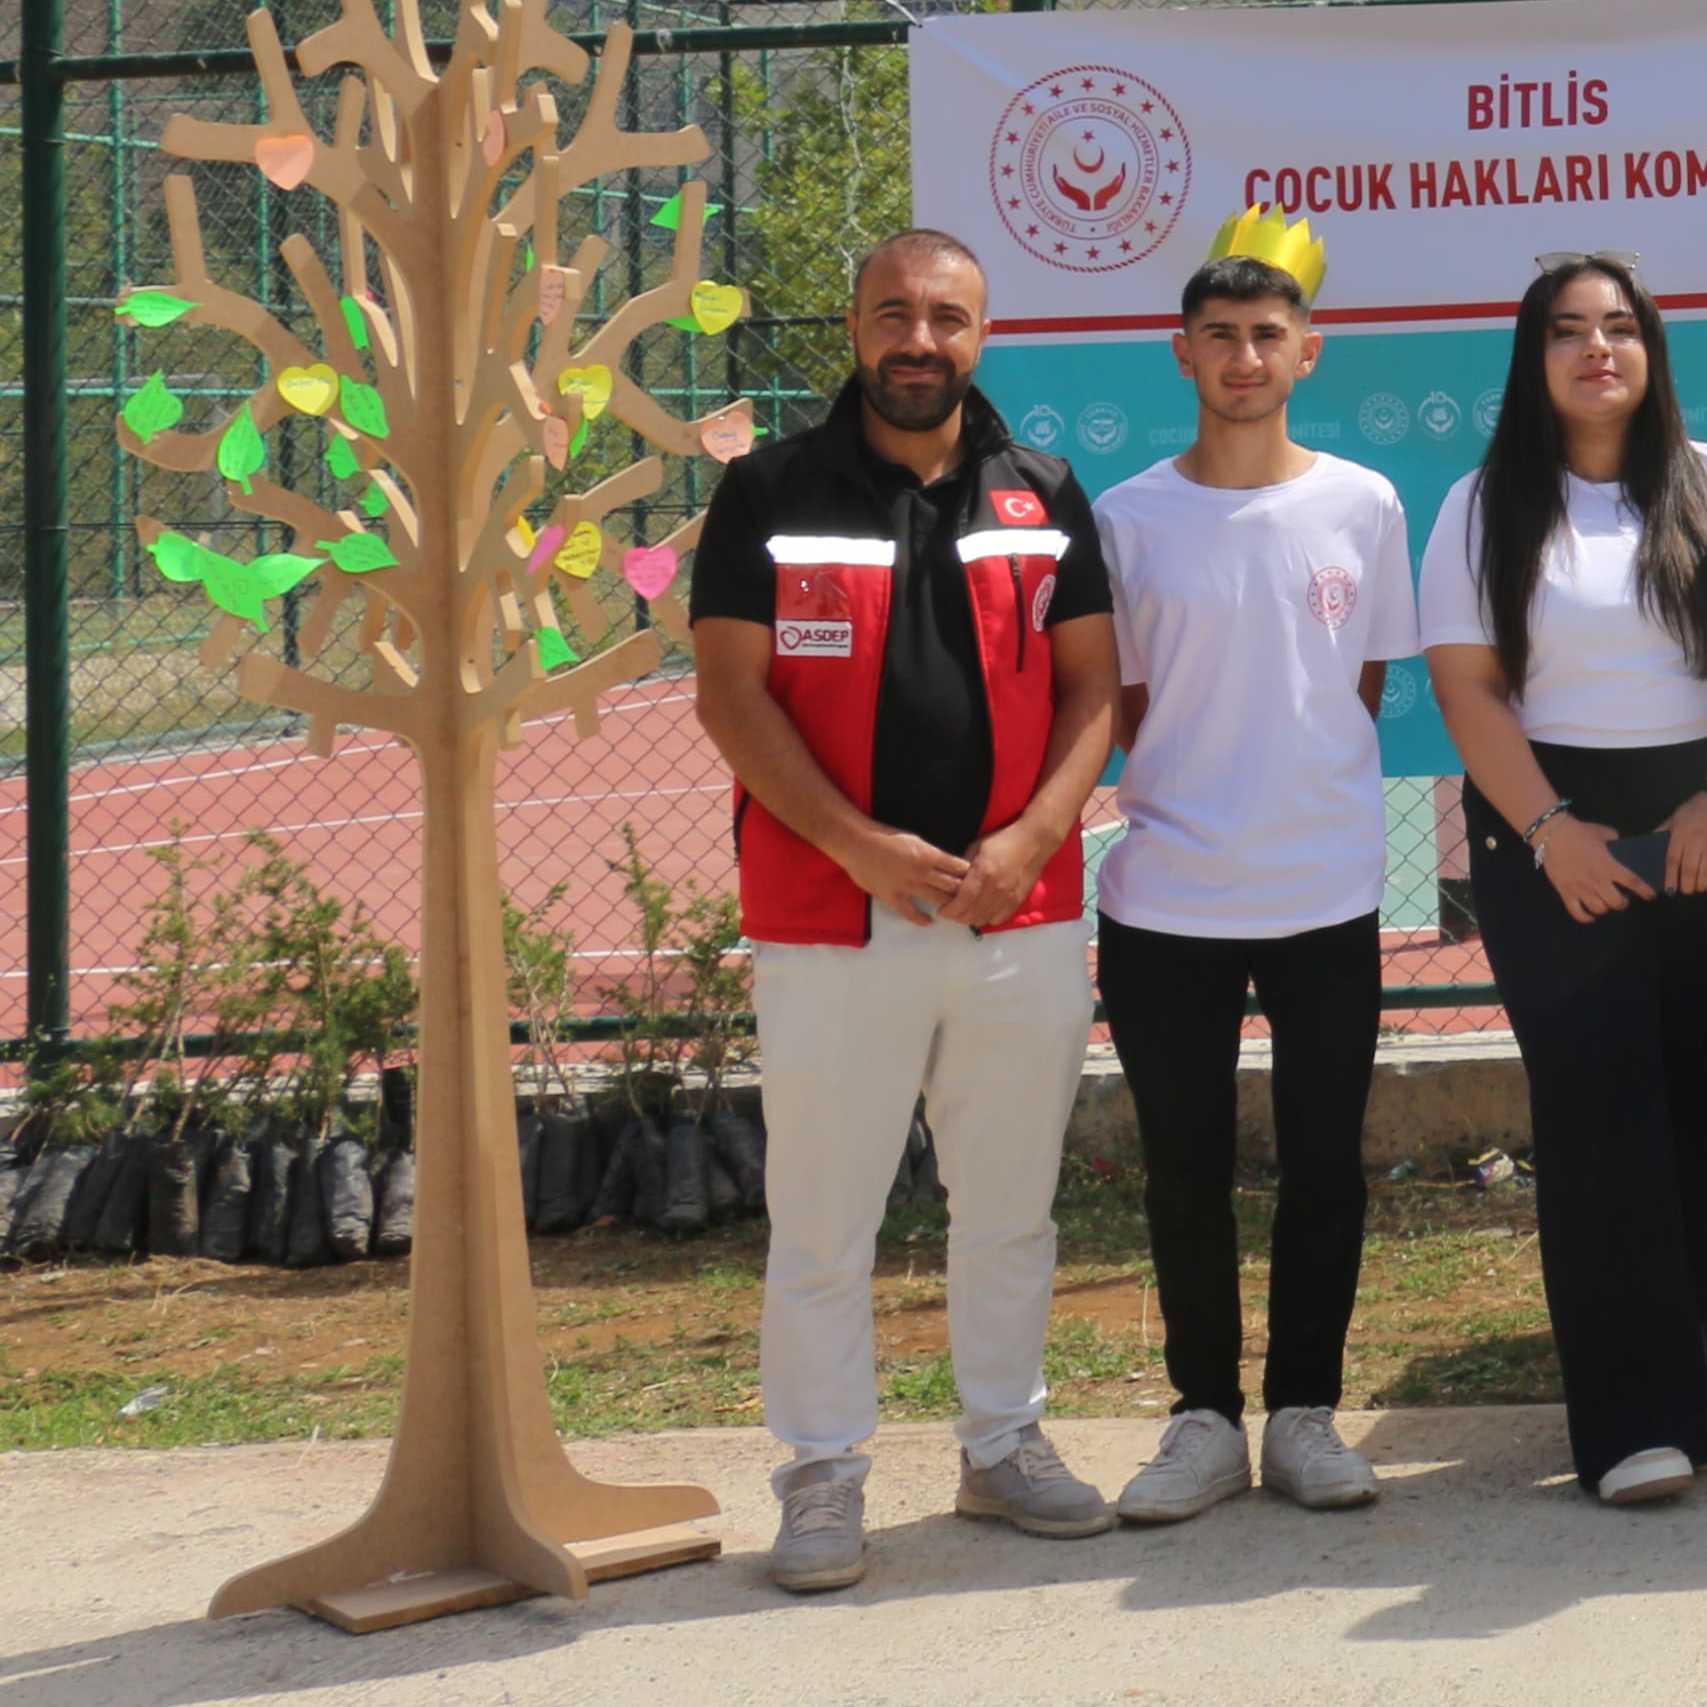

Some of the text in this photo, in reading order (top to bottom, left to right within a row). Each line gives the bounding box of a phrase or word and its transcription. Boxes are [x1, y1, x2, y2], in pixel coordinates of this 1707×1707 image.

[1047, 104, 1070, 126] AİLE
[1072, 103, 1088, 114] VE
[1089, 103, 1130, 125] SOSYAL
[1467, 70, 1609, 130] BİTLİS
[1410, 154, 1609, 209] HAKLARI
[803, 629, 849, 642] ASDEP
